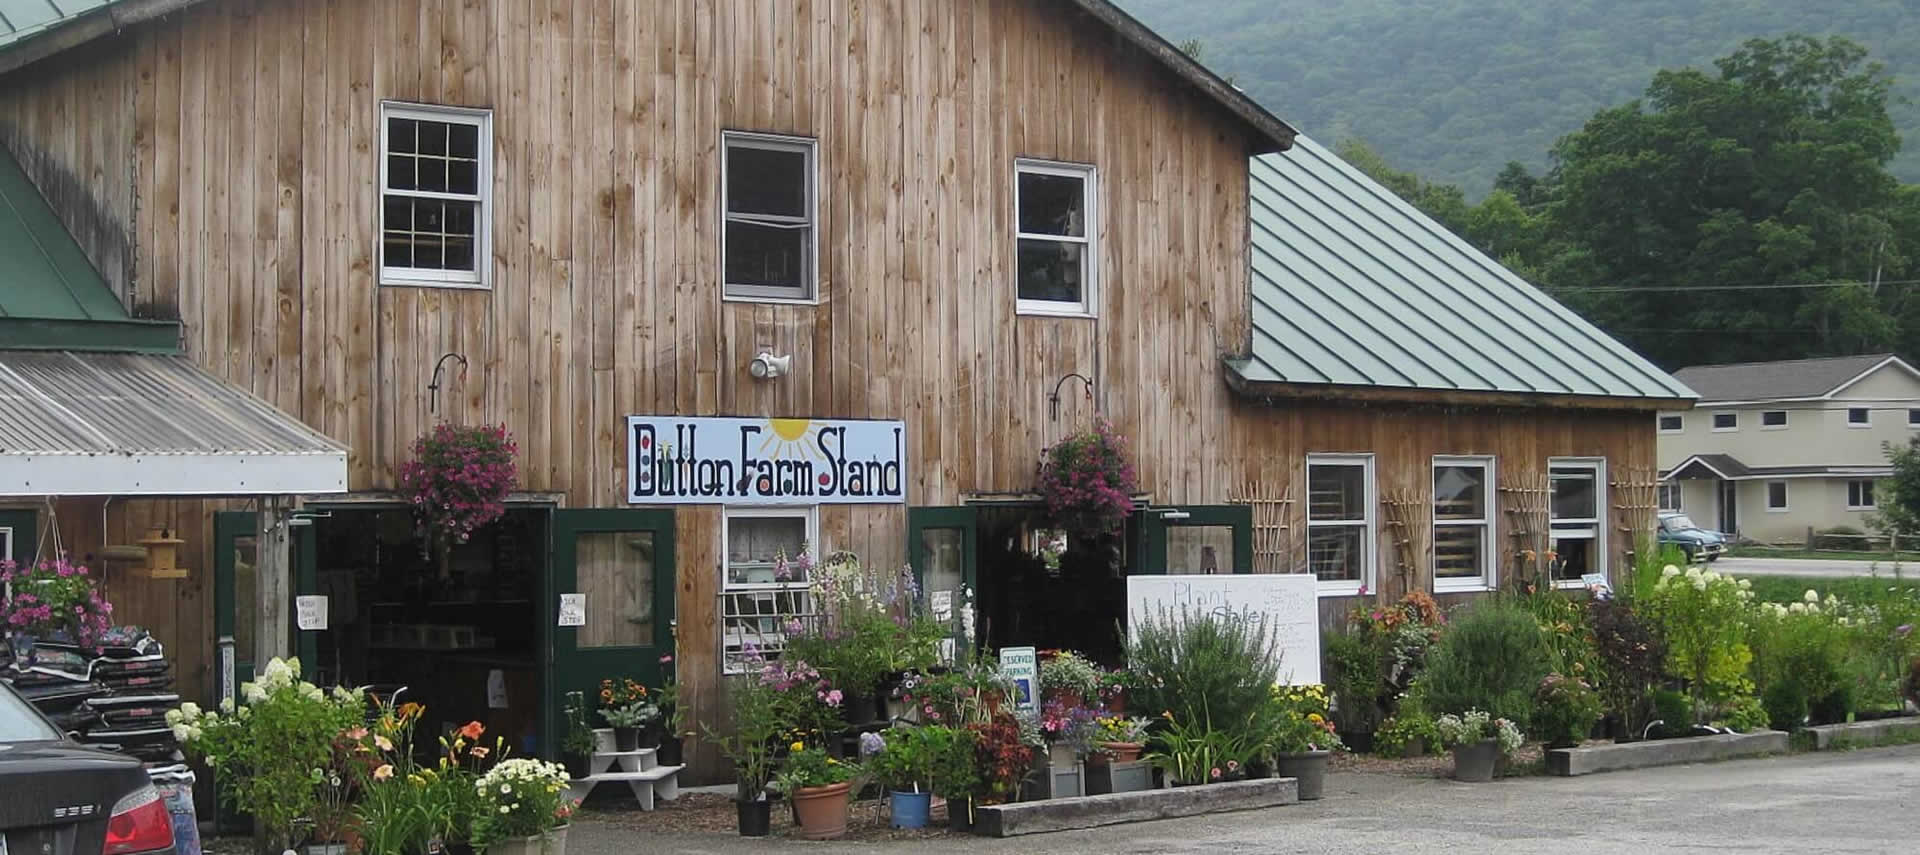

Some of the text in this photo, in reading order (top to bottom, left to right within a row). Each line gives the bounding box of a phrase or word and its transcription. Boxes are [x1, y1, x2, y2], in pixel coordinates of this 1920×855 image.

[634, 424, 902, 496] Dutton Farm Stand
[1173, 582, 1232, 605] Plant
